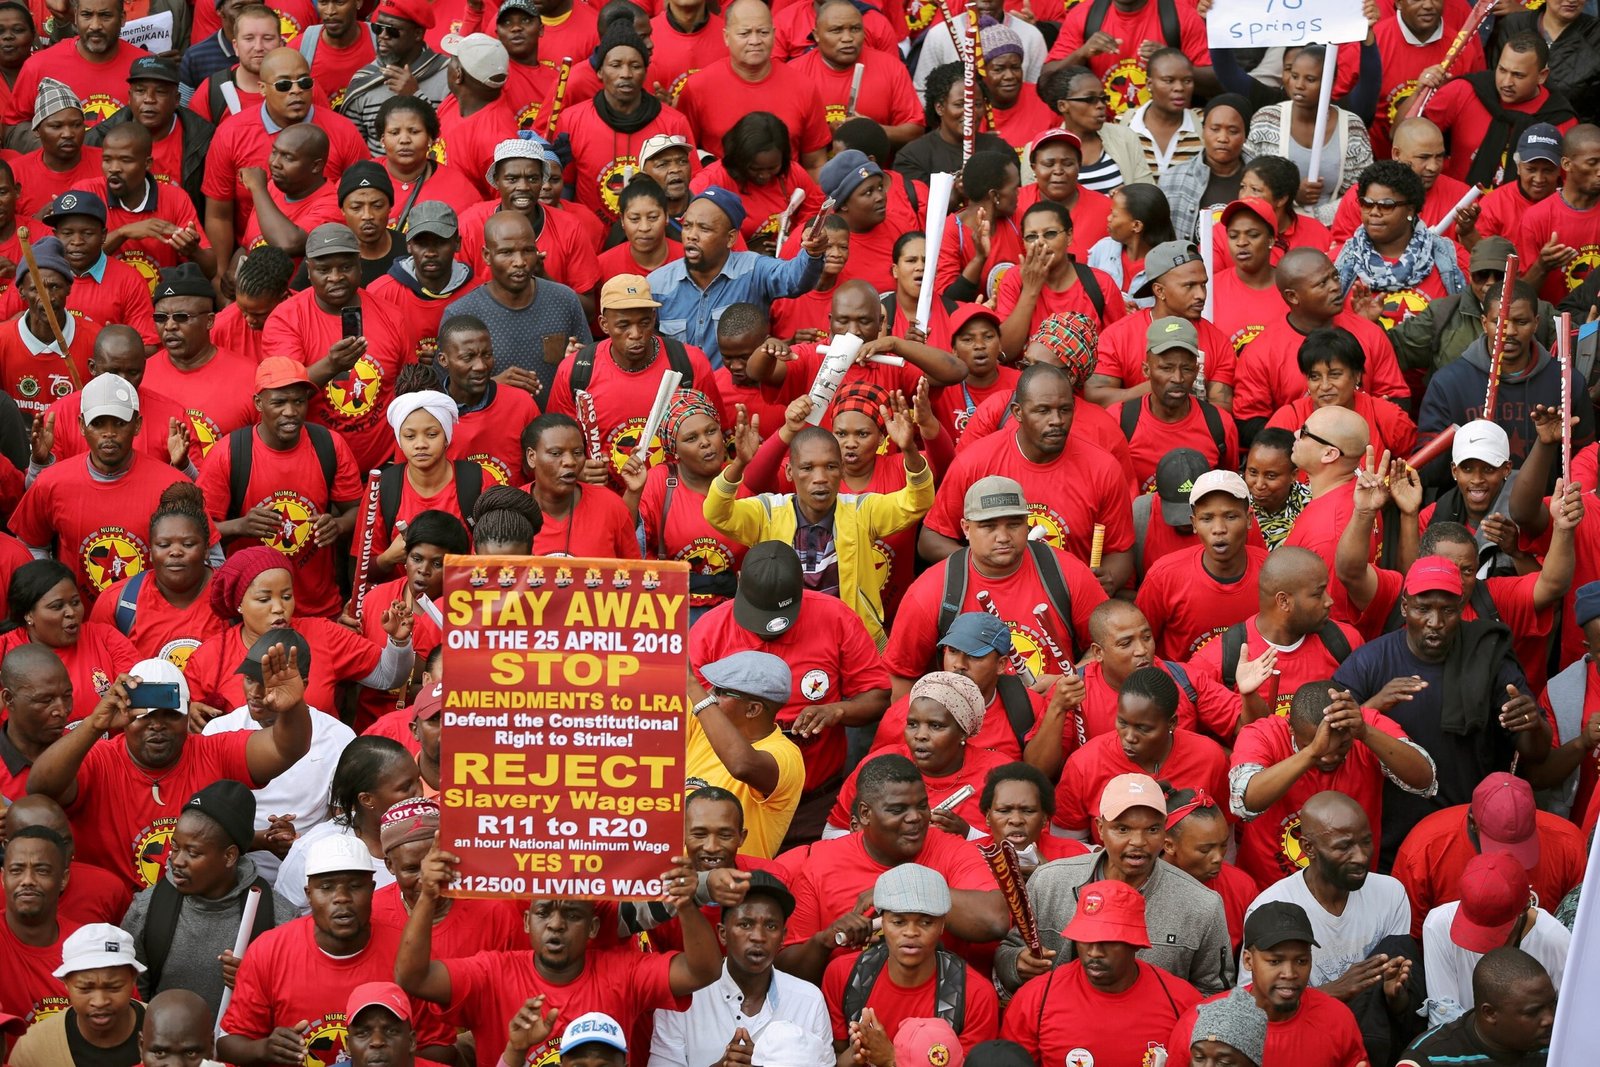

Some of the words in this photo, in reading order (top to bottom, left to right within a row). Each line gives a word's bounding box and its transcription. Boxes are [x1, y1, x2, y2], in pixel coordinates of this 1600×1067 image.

[1229, 18, 1322, 44] springs
[964, 37, 974, 87] R12500
[963, 90, 974, 137] LIVING
[590, 425, 601, 462] WAG
[274, 490, 297, 498] NUMSA
[366, 481, 380, 526] WAGE
[100, 526, 124, 534] NUMSA
[694, 537, 717, 545] NUMSA
[360, 527, 375, 579] LIVING
[448, 590, 553, 626] STAY
[564, 591, 685, 629] AWAY
[448, 630, 479, 649] ON
[485, 630, 528, 649] THE
[533, 630, 559, 651] 25
[565, 632, 627, 651] APRIL
[633, 633, 682, 654] 2018
[490, 651, 640, 686] STOP
[445, 691, 604, 710] AMENDMENTS
[611, 694, 632, 710] to
[640, 694, 683, 712] LRA
[444, 712, 508, 726] Defend
[514, 713, 544, 727] the
[549, 714, 678, 730] Constitutional
[495, 731, 543, 746] Right
[549, 732, 567, 745] to
[573, 732, 633, 747] Strike!
[454, 753, 675, 788] REJECT
[445, 789, 560, 813] Slavery
[569, 791, 680, 815] Wages!
[152, 818, 177, 827] NUMSA
[478, 816, 533, 834] R11
[547, 818, 578, 835] to
[589, 818, 647, 837] R20
[454, 839, 470, 847] an
[475, 837, 506, 848] hour
[510, 838, 564, 849] National
[568, 839, 629, 851] Minimum
[633, 841, 669, 854] Wage
[513, 853, 562, 872] YES
[570, 854, 602, 872] TO
[533, 878, 605, 895] LIVING
[612, 879, 670, 897] WAG
[43, 997, 69, 1006] NUMSA
[571, 1019, 619, 1036] RELAY
